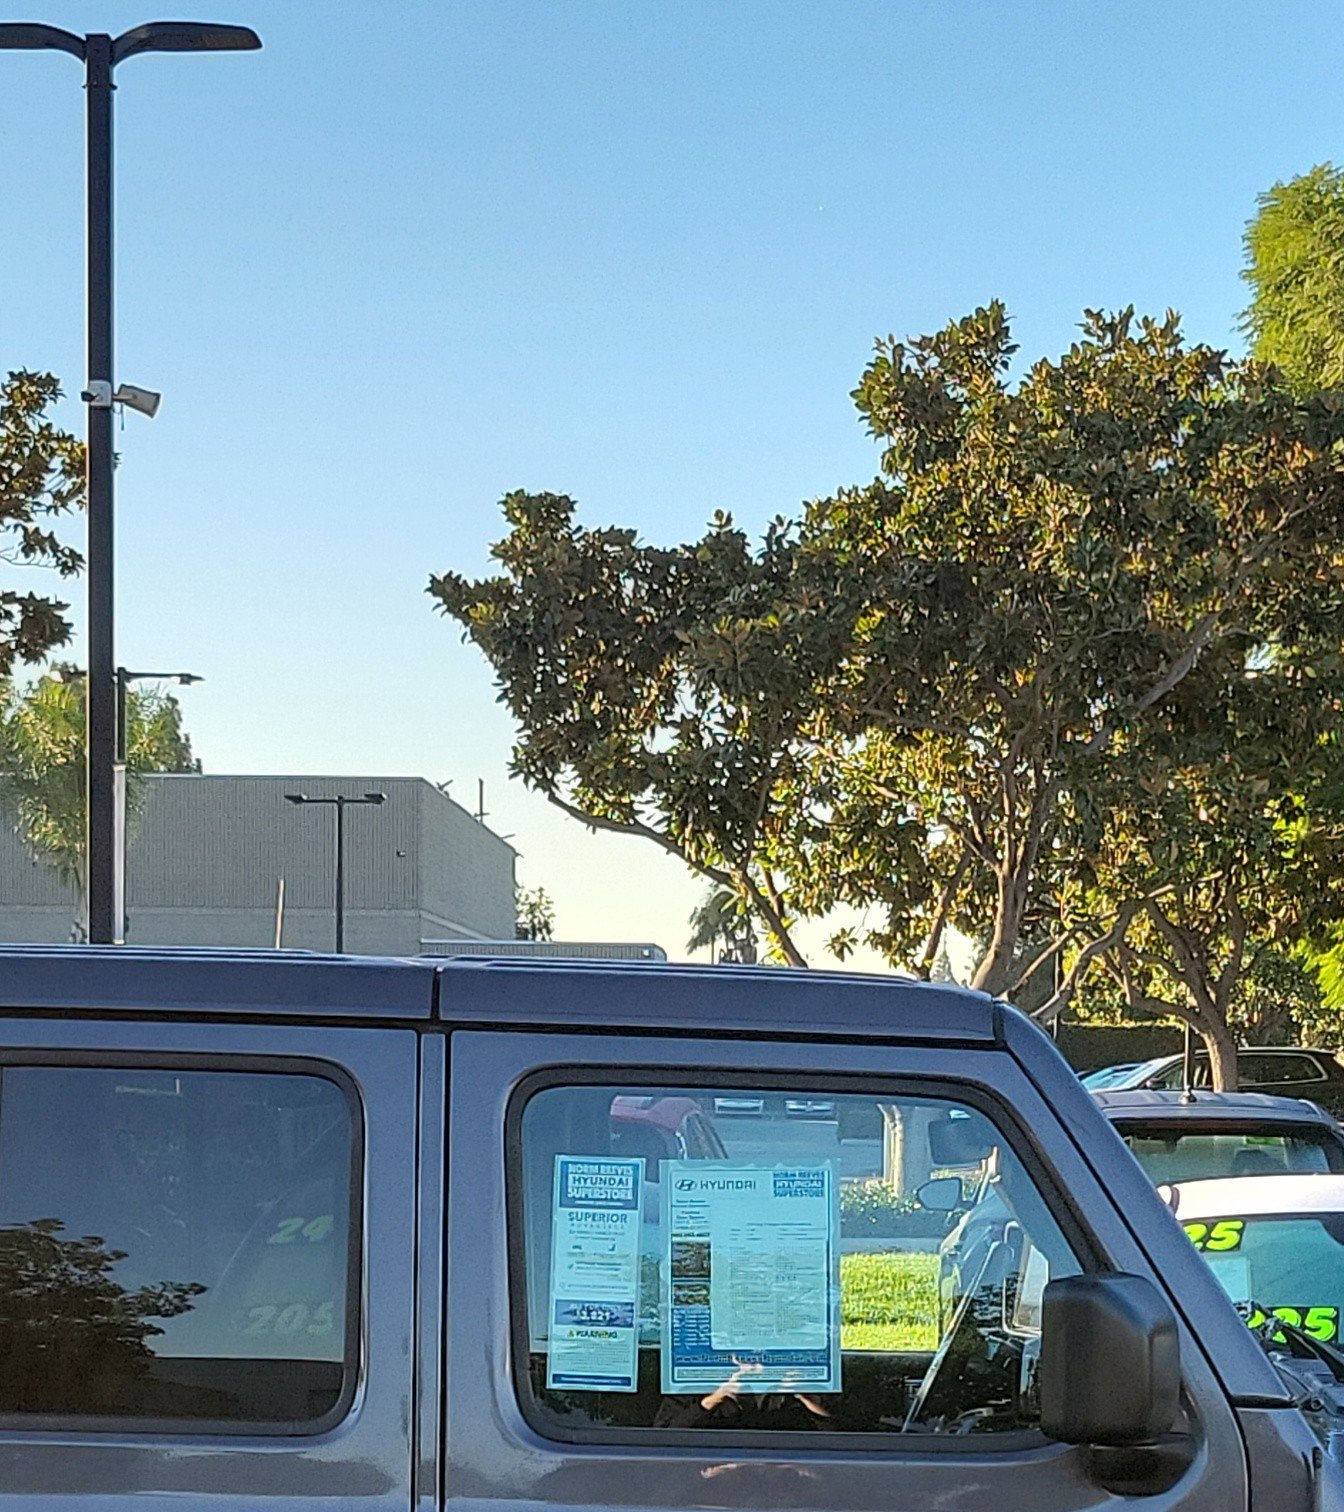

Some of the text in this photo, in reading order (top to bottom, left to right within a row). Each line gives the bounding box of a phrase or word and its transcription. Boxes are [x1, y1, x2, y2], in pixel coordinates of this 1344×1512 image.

[572, 1176, 630, 1187] HYUNDAI
[701, 1180, 756, 1190] HYUNDAI
[567, 1211, 628, 1223] SUPERIOR
